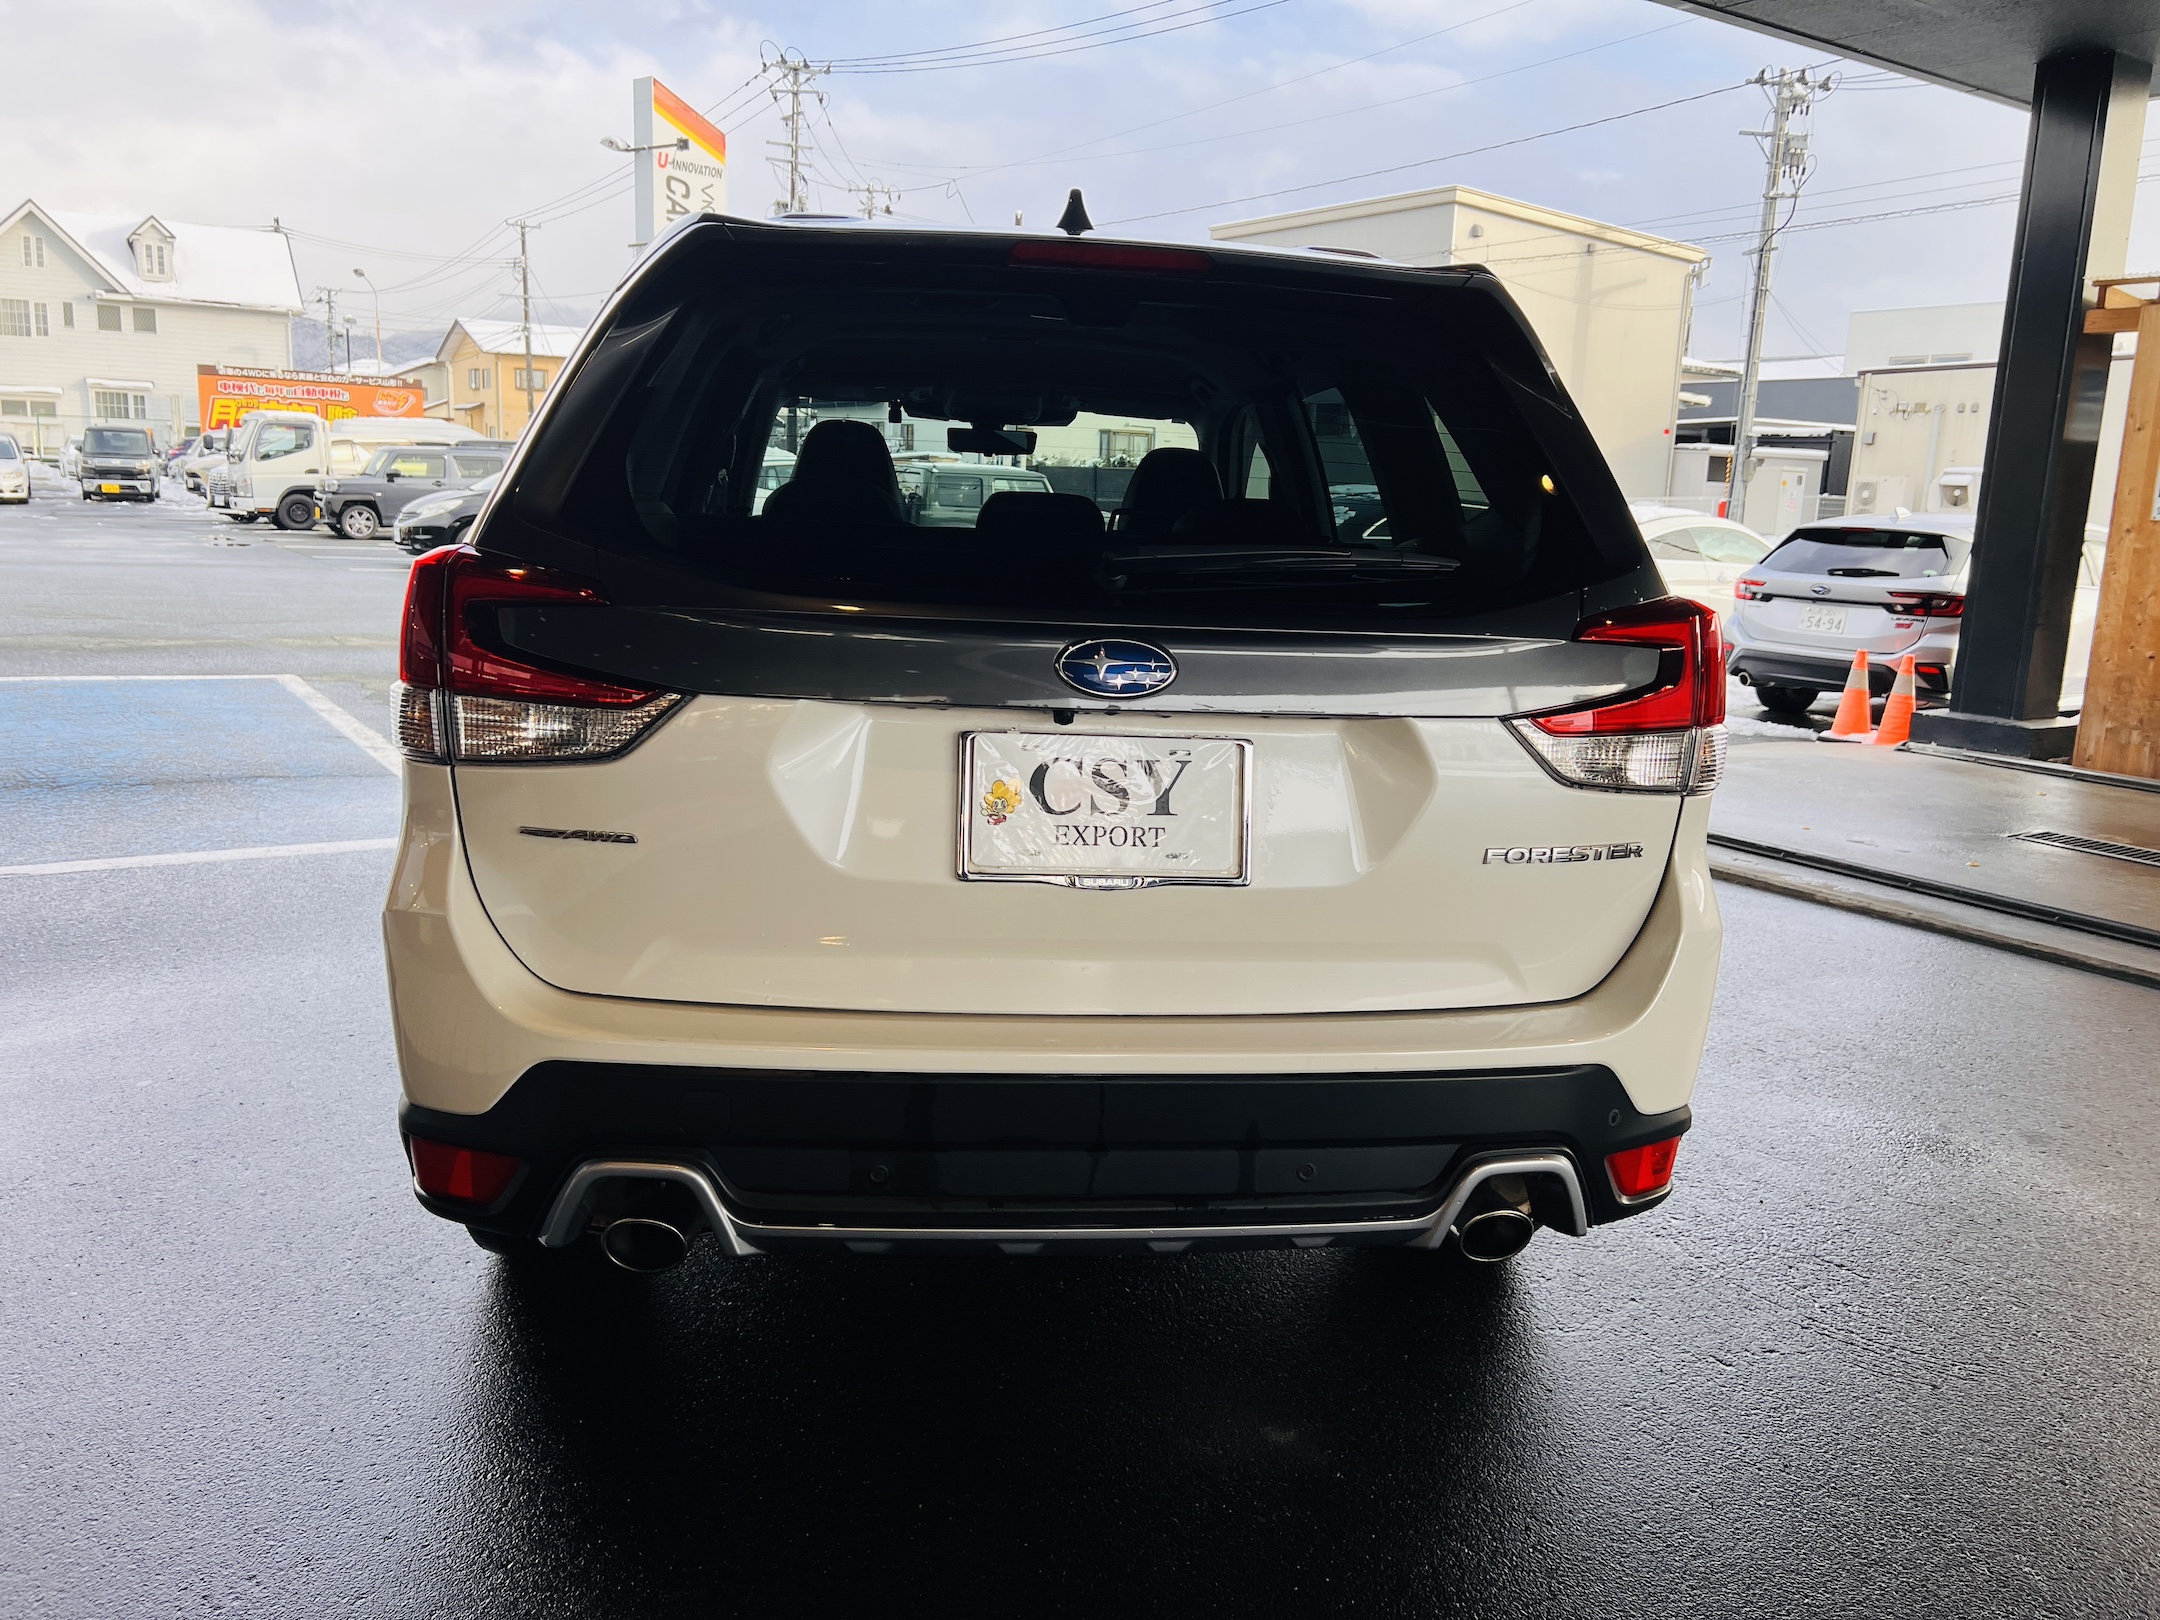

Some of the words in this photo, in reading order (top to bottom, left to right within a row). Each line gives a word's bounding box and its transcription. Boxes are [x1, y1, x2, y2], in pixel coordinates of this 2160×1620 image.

[665, 175, 691, 222] CA
[1806, 615, 1843, 631] 54-94
[1029, 757, 1192, 817] CSY
[1053, 825, 1166, 848] EXPORT
[1482, 842, 1644, 865] FORESTER
[1082, 877, 1130, 888] SUBARU
